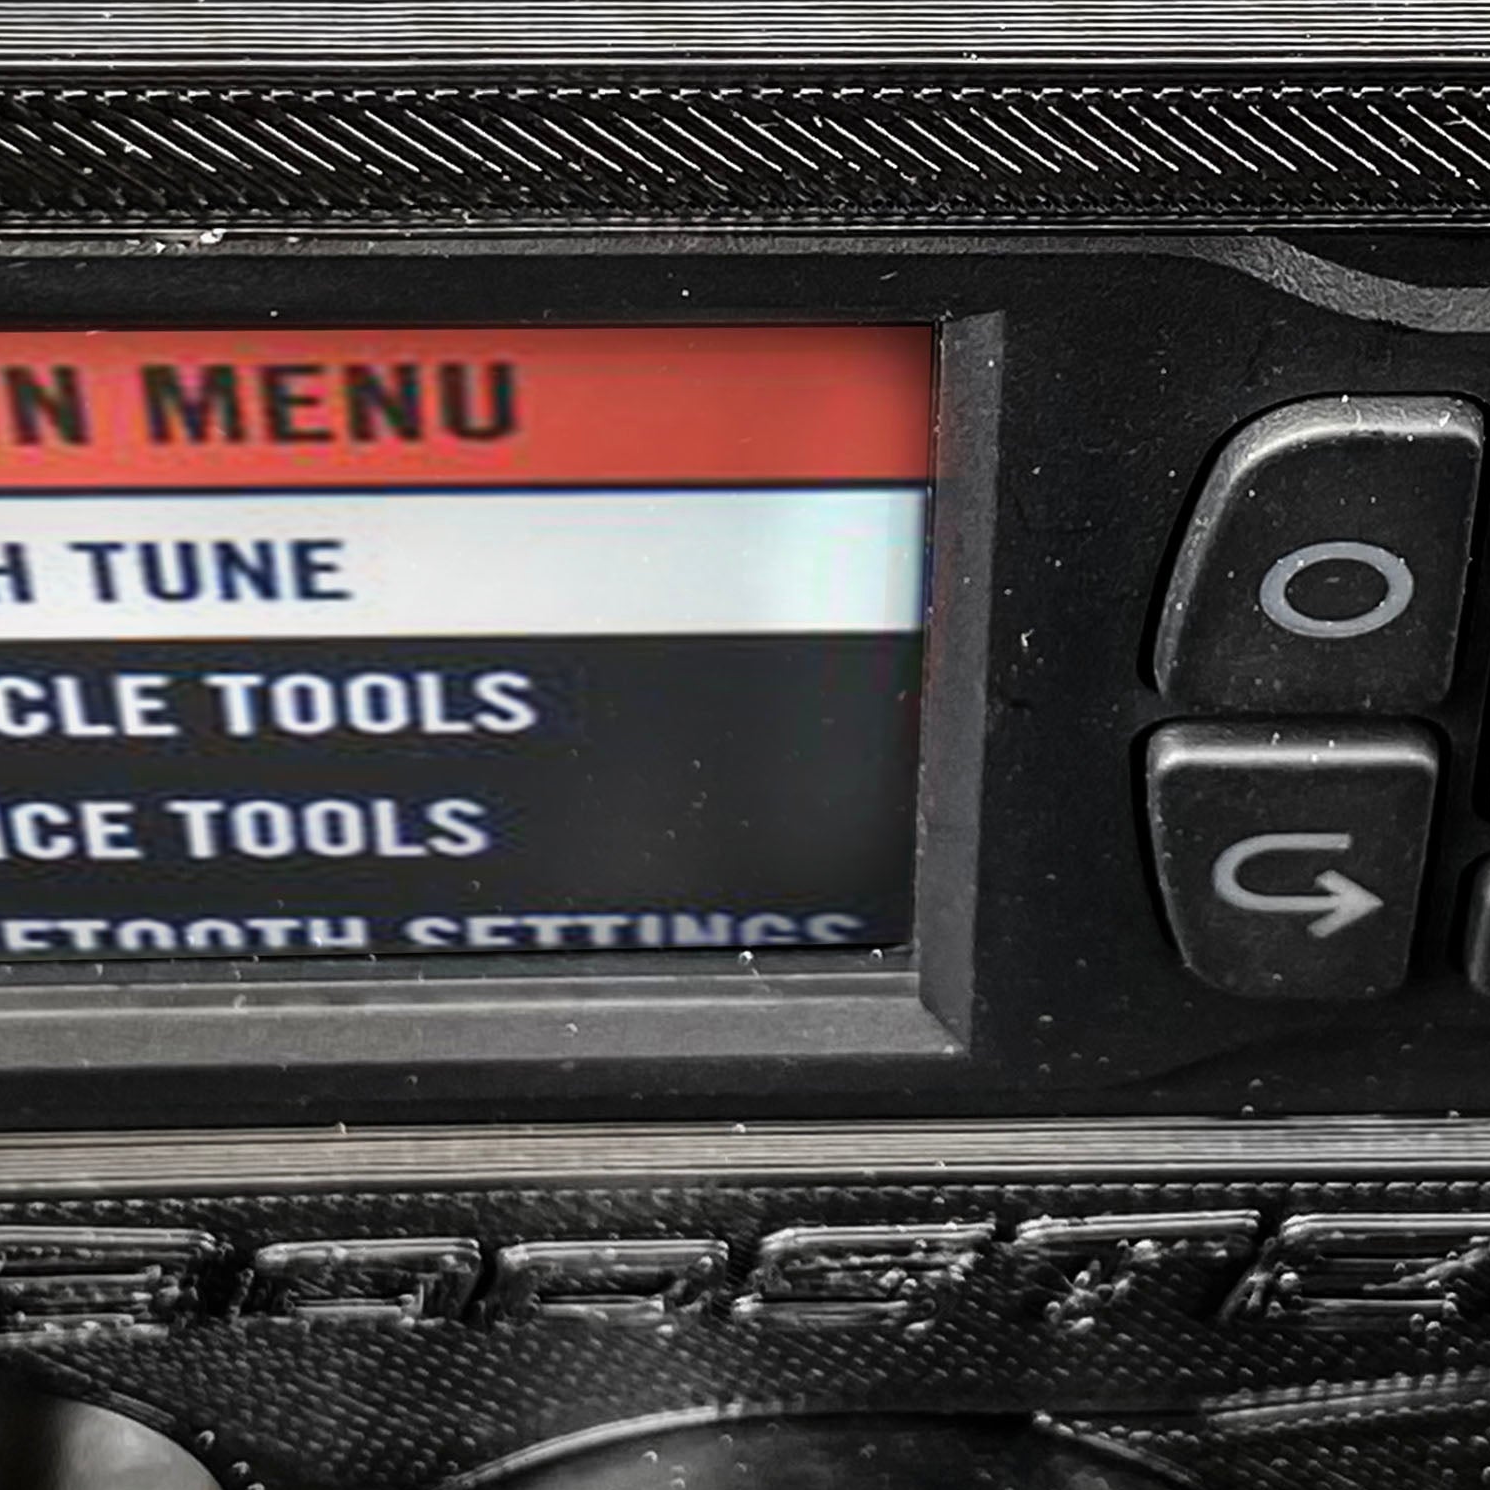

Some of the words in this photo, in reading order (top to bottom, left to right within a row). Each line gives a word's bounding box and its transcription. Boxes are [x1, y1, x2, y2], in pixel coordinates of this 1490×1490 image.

[140, 362, 521, 444] MENU
[69, 539, 351, 603] TUNE
[207, 672, 537, 736] TOOLS
[165, 798, 491, 859] TOOLS
